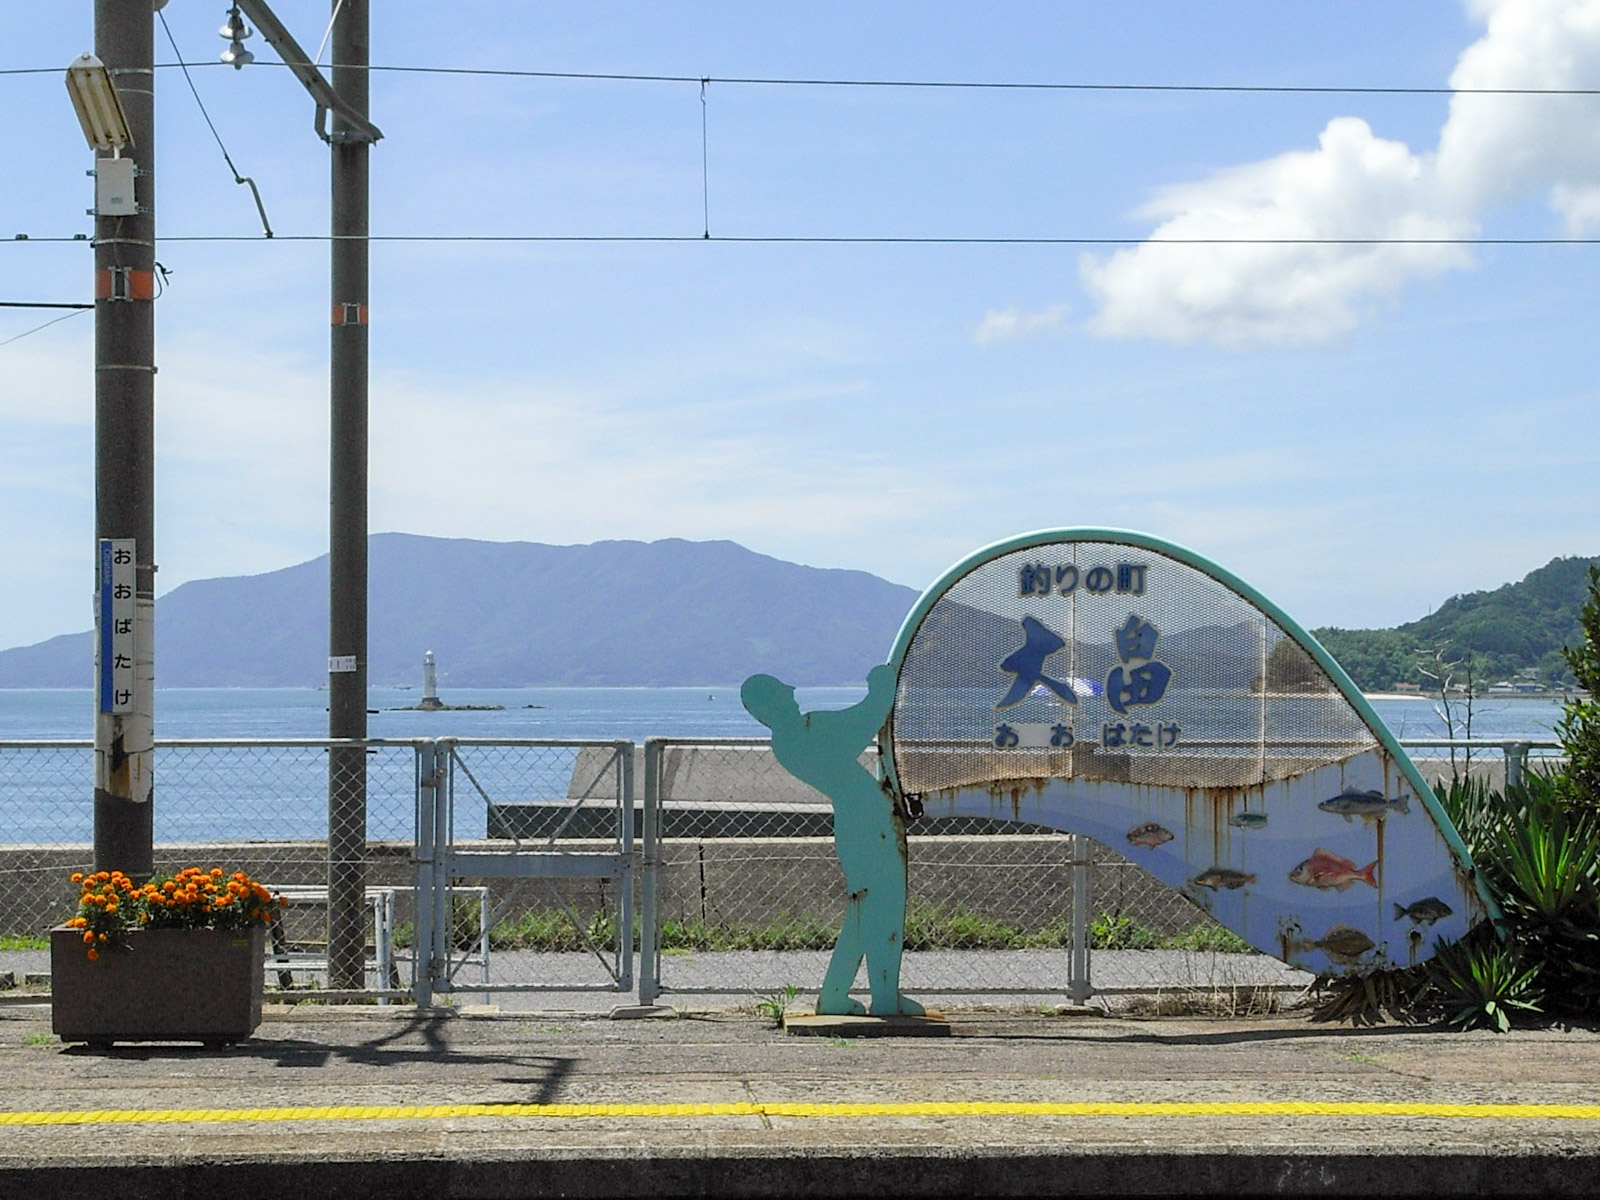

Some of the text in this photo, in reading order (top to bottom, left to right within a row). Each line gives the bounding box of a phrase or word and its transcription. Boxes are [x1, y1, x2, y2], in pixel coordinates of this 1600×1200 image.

[113, 548, 132, 706] おおばたけ
[1020, 563, 1147, 596] 釣りの町
[994, 614, 1172, 715] 大畠
